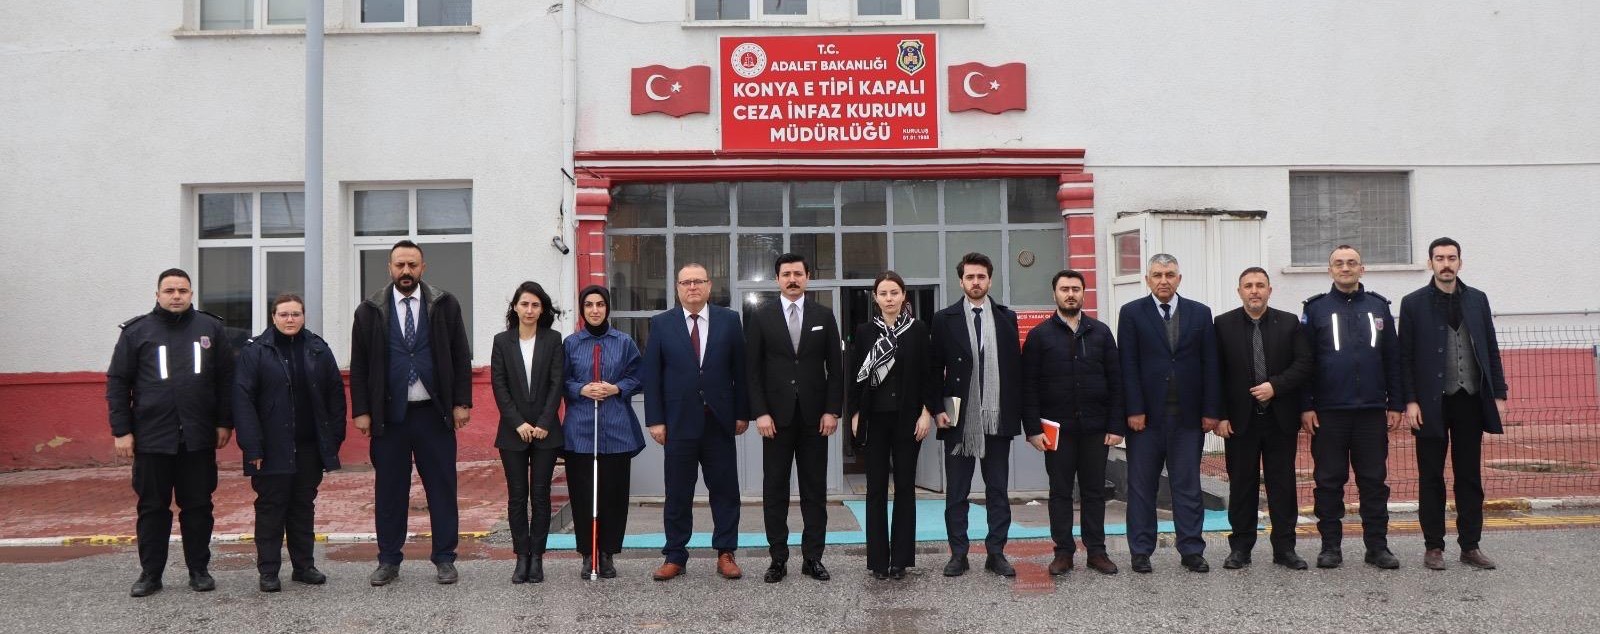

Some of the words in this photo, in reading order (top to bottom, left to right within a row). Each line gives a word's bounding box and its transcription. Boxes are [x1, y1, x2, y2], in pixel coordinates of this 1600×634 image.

[818, 44, 839, 54] T.C.
[771, 61, 817, 71] ADALET
[821, 57, 887, 71] BAKANLIĞI
[733, 82, 799, 97] KONYA
[804, 82, 814, 96] E
[819, 77, 853, 95] TİPİ
[859, 79, 925, 95] KAPALI
[733, 105, 783, 120] CEZA
[788, 101, 841, 119] İNFAZ
[847, 103, 926, 118] KURUMU
[770, 122, 891, 142] MÜDÜRLÜĞÜ
